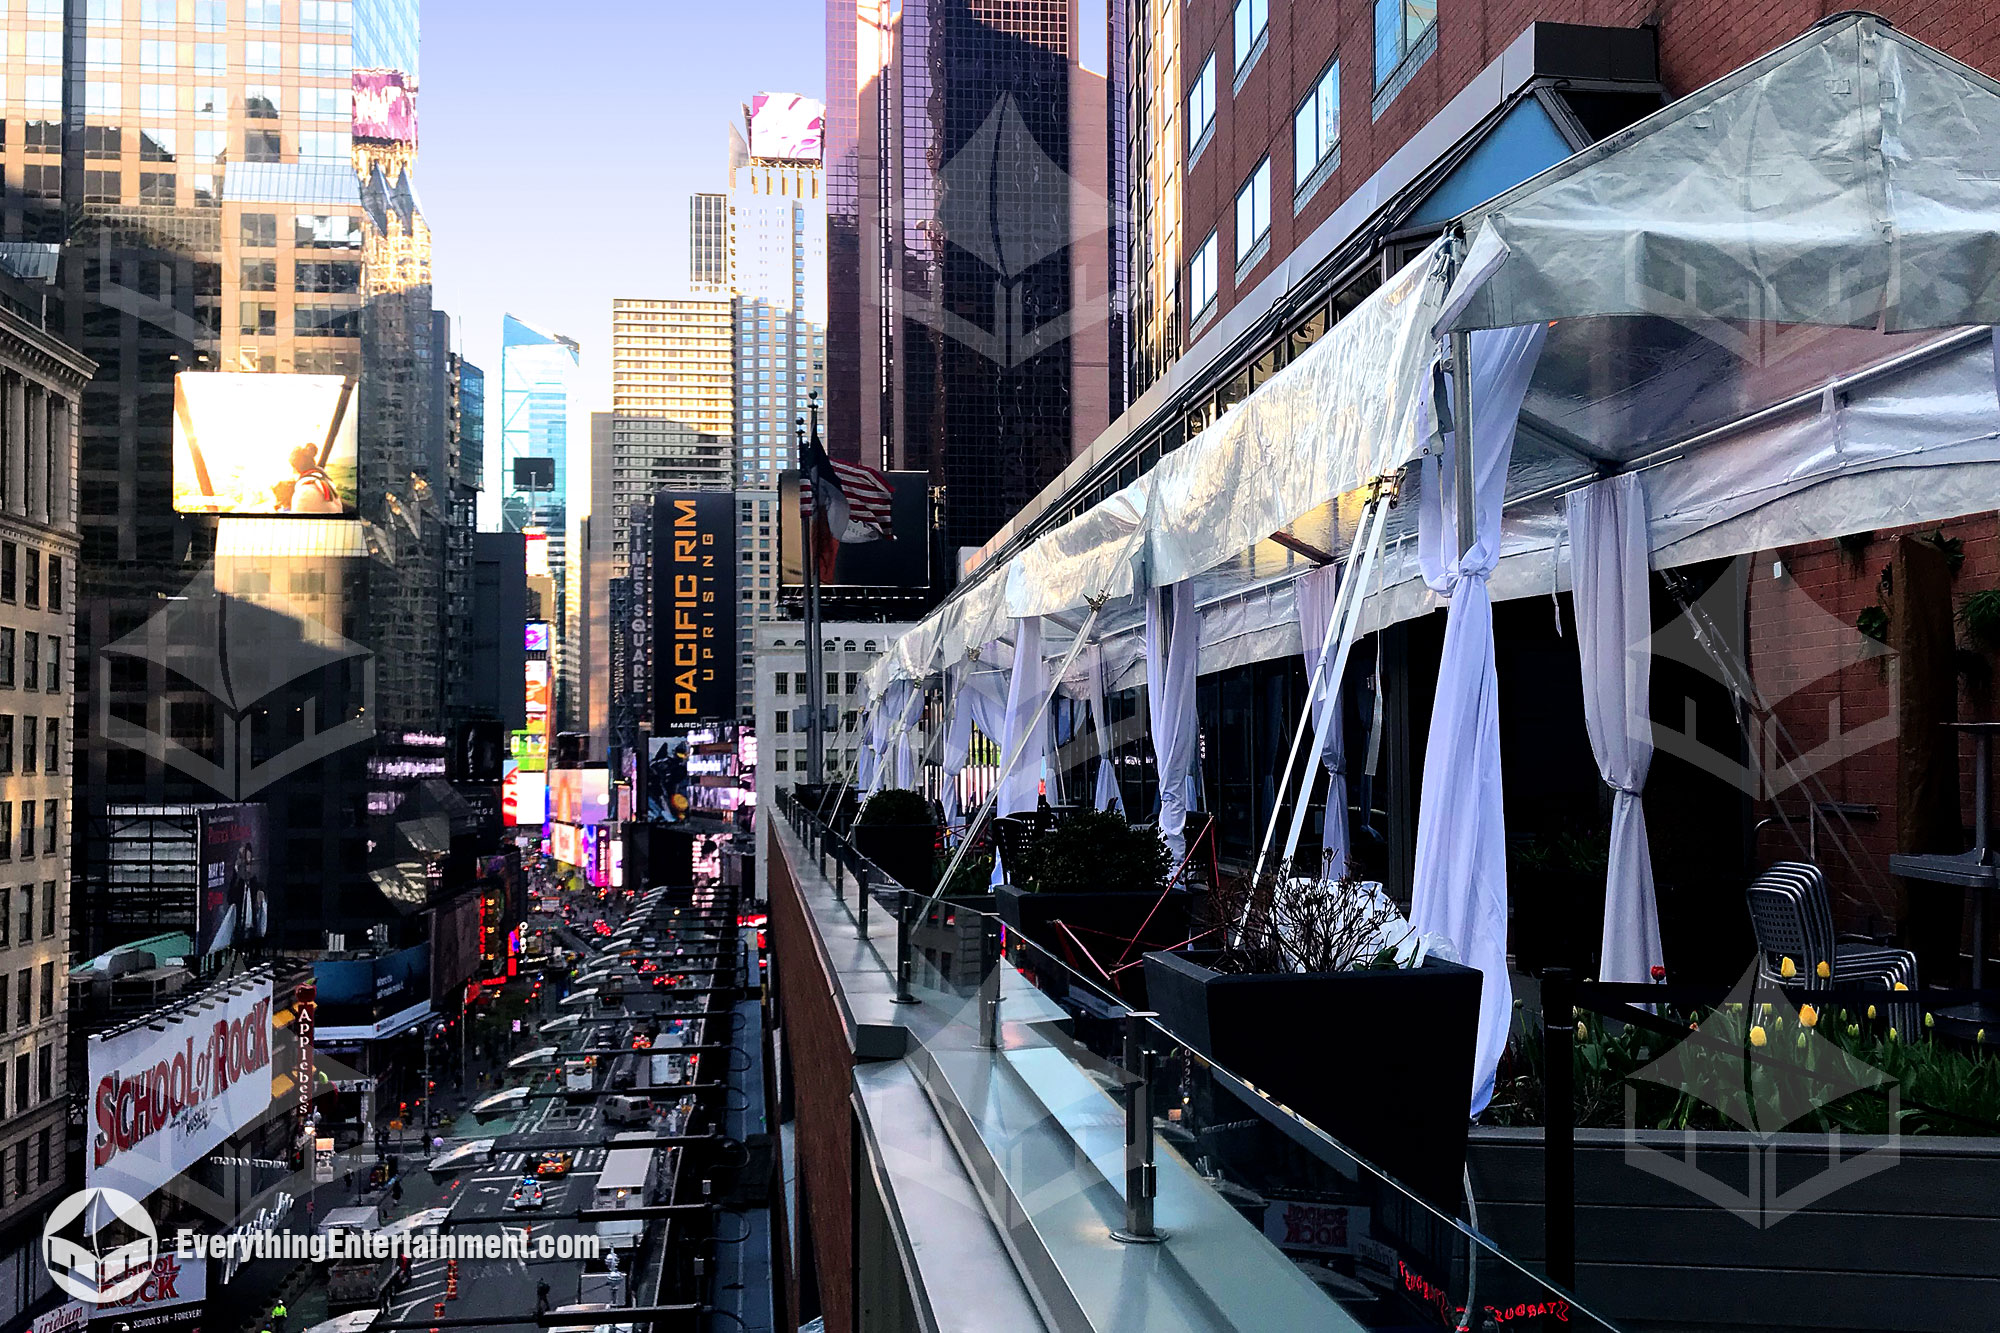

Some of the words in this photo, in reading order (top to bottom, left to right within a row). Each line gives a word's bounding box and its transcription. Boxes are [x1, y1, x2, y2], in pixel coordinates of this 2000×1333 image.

[631, 522, 646, 596] TIMES
[674, 500, 697, 562] RIM
[631, 604, 647, 694] SQUARE
[674, 574, 698, 715] PACIFIC
[702, 533, 715, 681] UPRISING
[94, 1036, 200, 1171] SCHOOL
[212, 996, 270, 1099] ROCK
